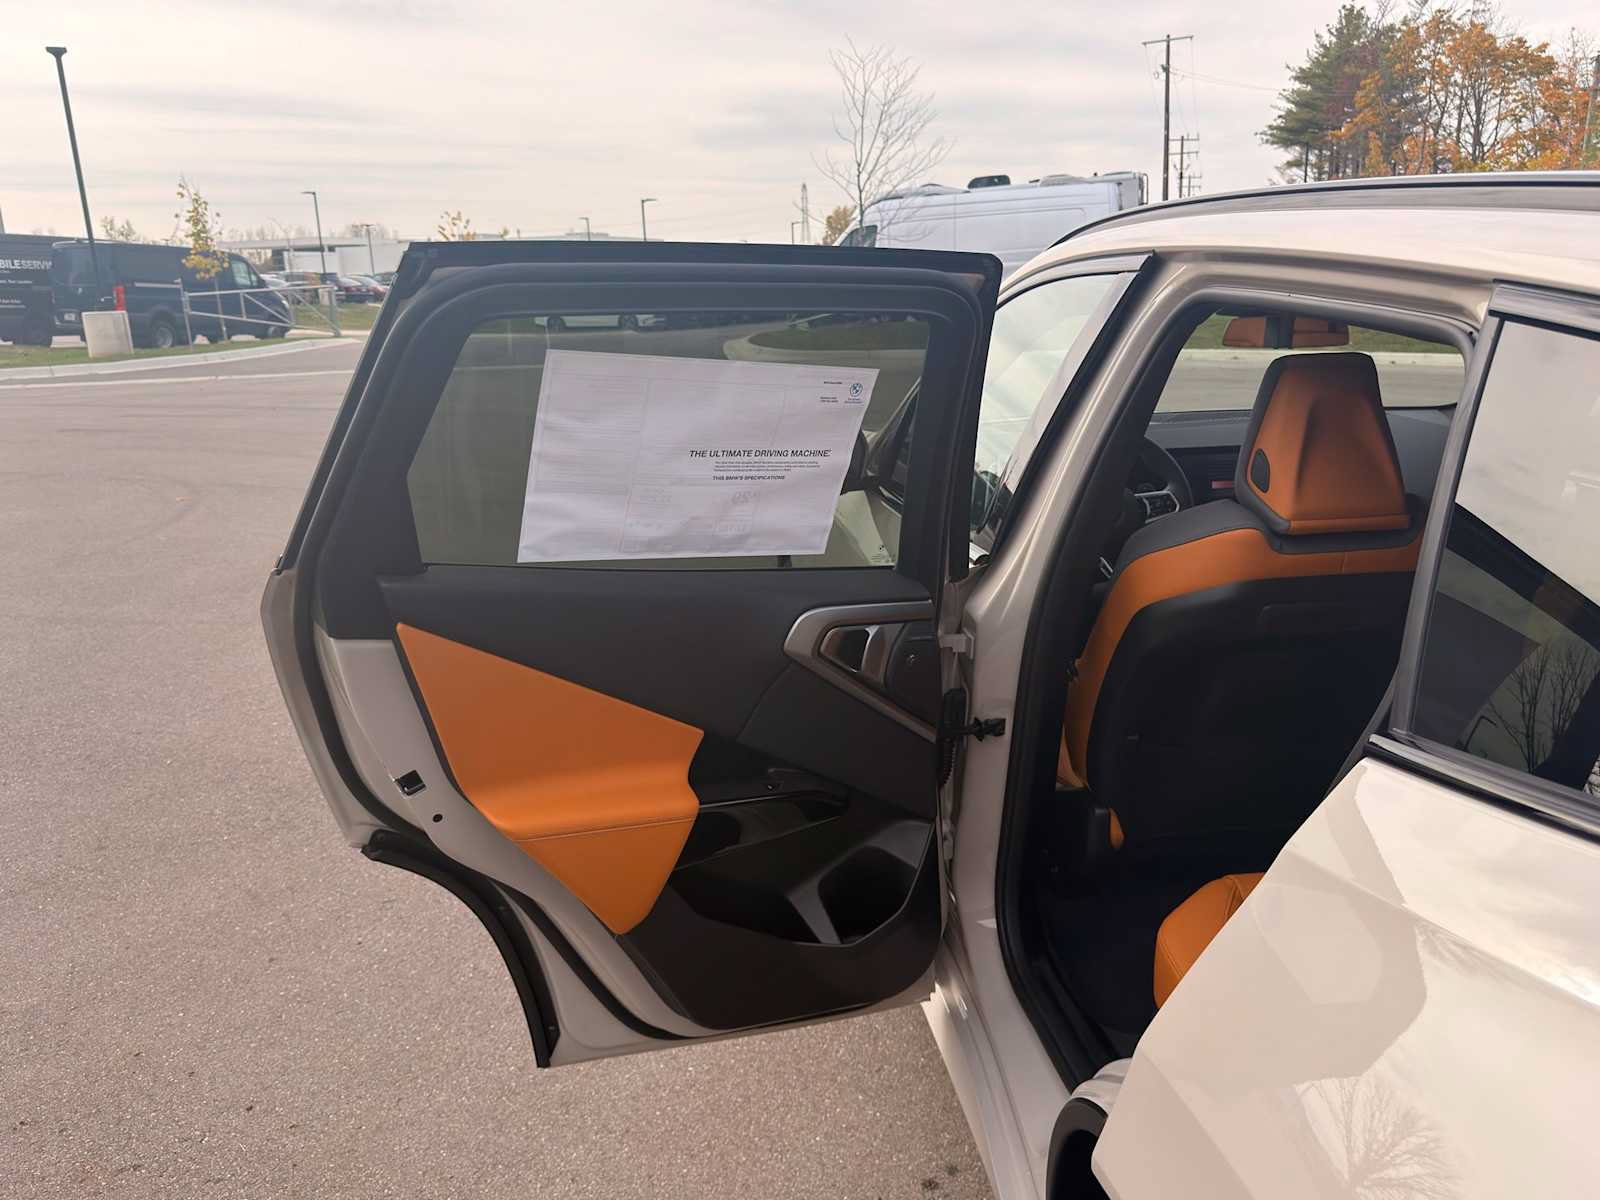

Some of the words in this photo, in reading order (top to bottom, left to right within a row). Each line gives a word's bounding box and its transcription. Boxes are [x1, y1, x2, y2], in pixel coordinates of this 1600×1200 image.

[689, 449, 708, 458] THE
[709, 449, 753, 458] ULTIMATE
[754, 449, 789, 458] DRIVING
